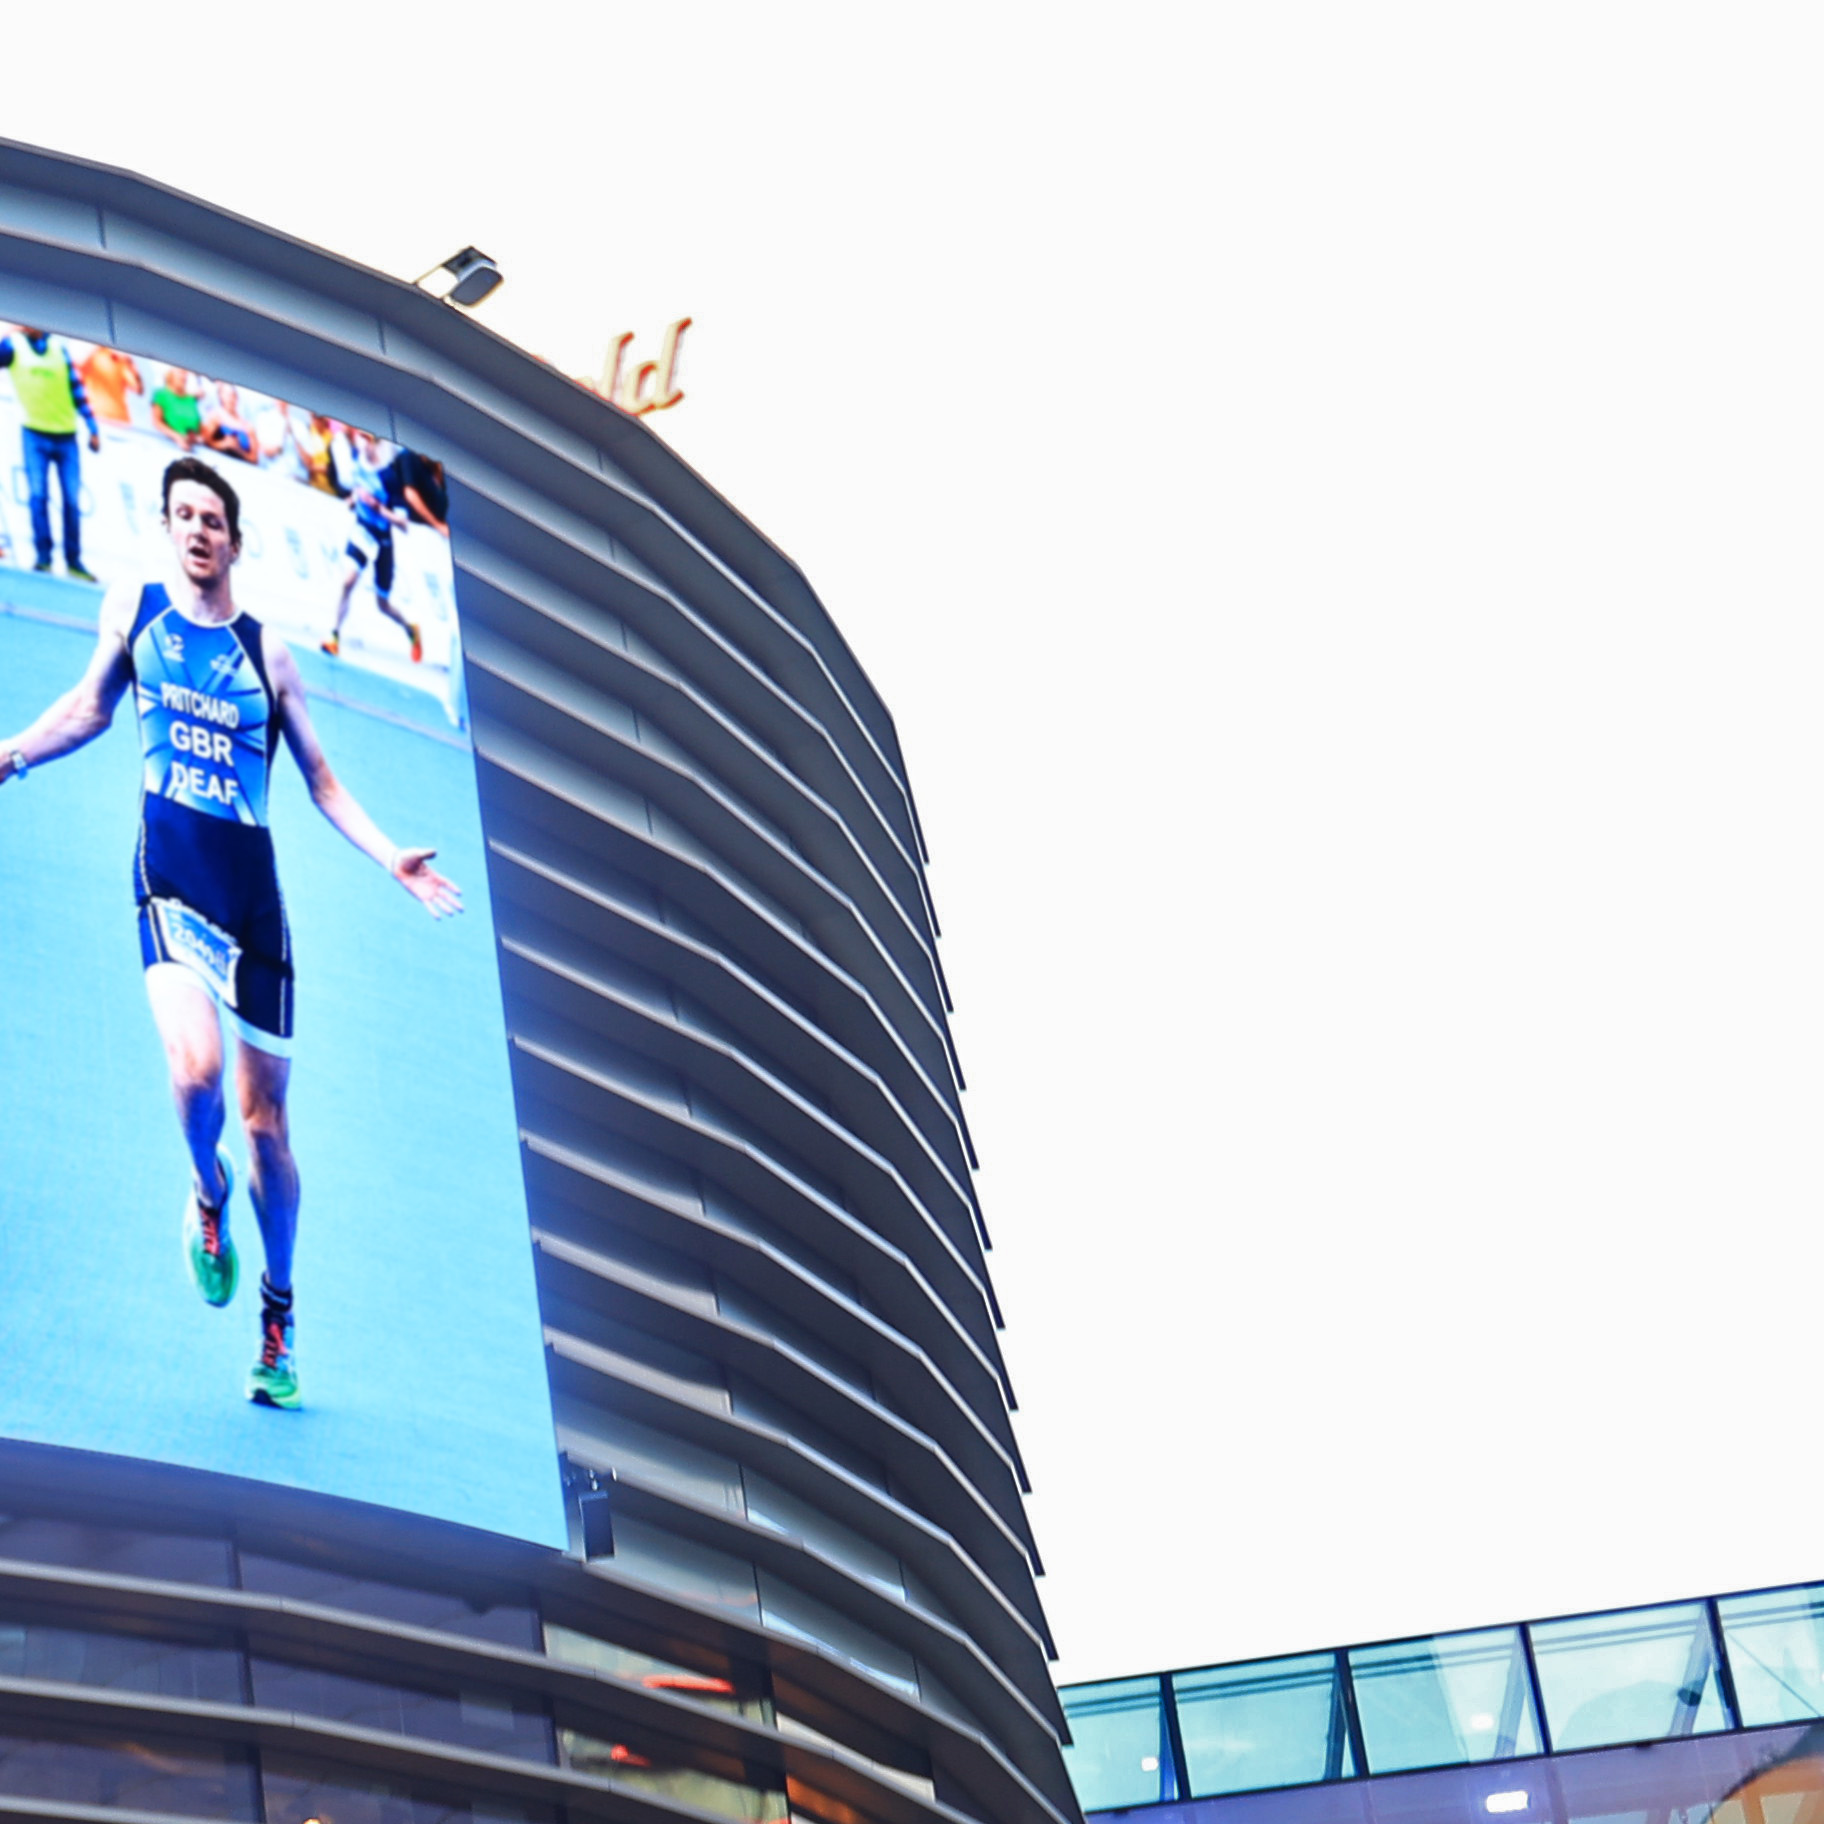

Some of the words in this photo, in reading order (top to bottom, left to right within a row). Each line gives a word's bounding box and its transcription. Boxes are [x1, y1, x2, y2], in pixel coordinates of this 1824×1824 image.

[160, 682, 240, 729] PRITCHARD
[169, 720, 234, 767] GBR
[171, 761, 239, 805] DEAF
